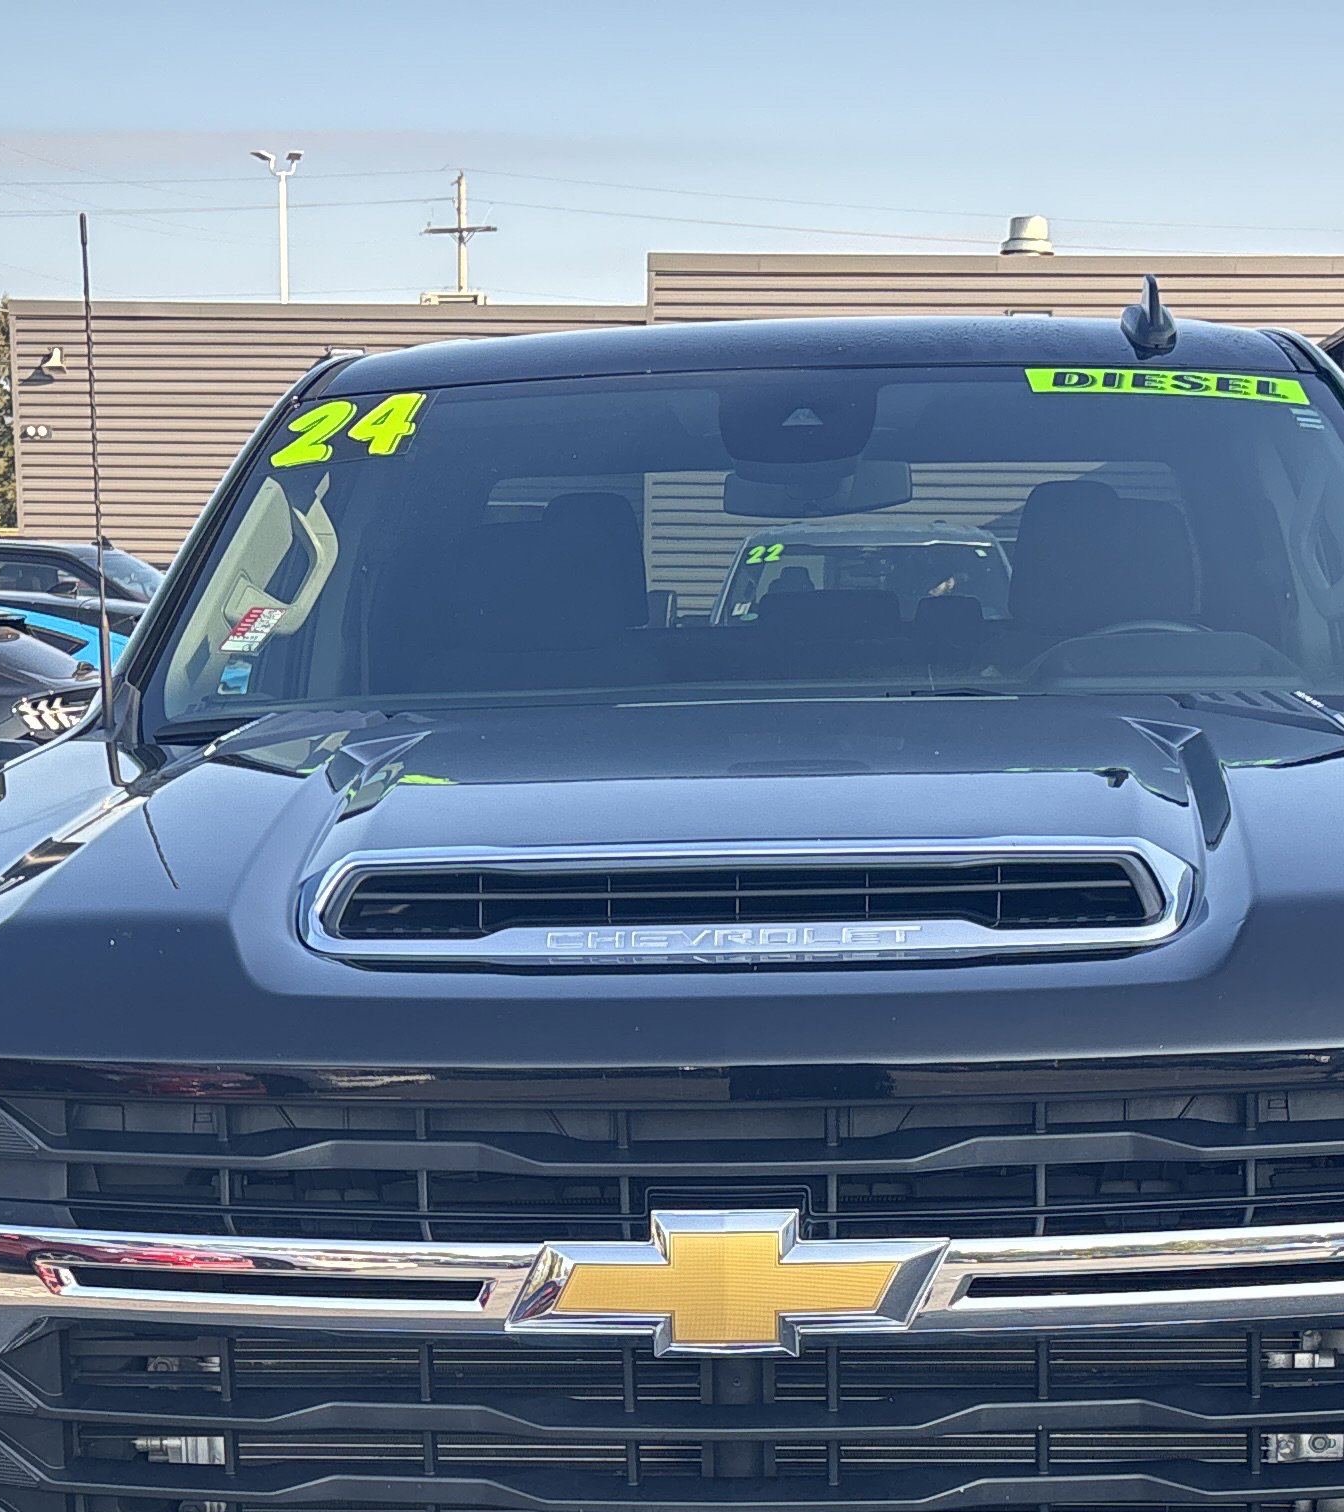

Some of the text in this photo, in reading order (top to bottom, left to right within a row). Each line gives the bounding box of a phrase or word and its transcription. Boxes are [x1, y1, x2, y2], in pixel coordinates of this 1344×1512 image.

[1052, 371, 1289, 399] DIESEL
[270, 393, 427, 468] 24
[745, 543, 785, 565] 22
[546, 926, 922, 949] CHEVROLET
